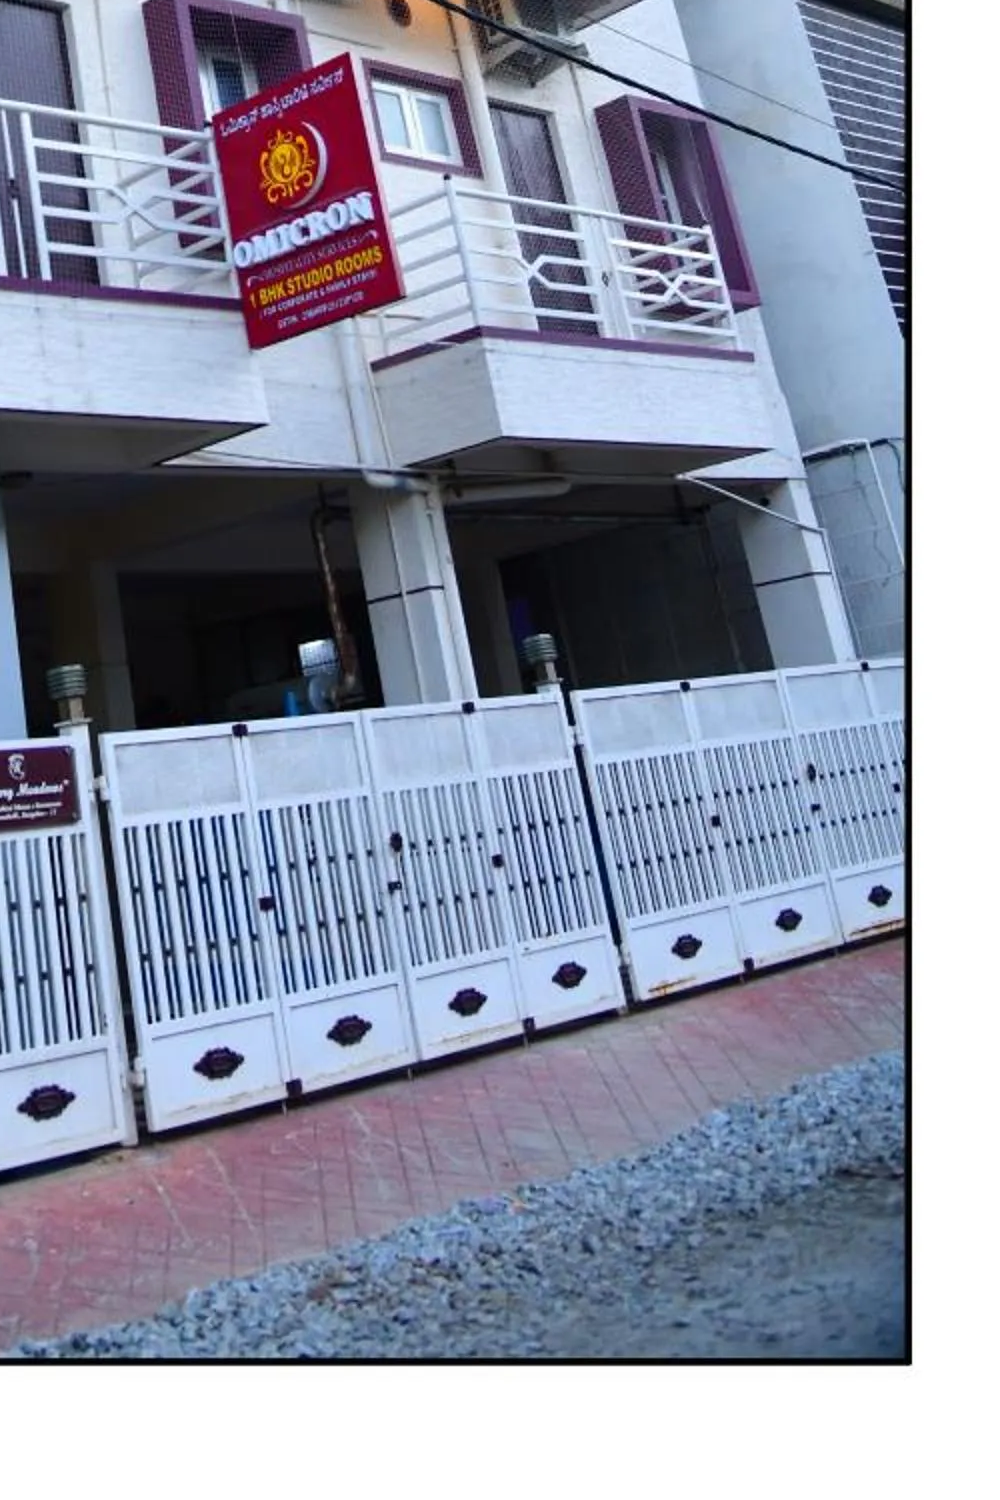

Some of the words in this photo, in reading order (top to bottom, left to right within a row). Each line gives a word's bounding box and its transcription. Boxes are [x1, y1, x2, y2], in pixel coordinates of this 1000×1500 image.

[234, 191, 374, 268] OMICRON
[259, 283, 286, 305] BHK
[287, 263, 334, 296] STUDIO
[335, 246, 384, 277] ROOMS
